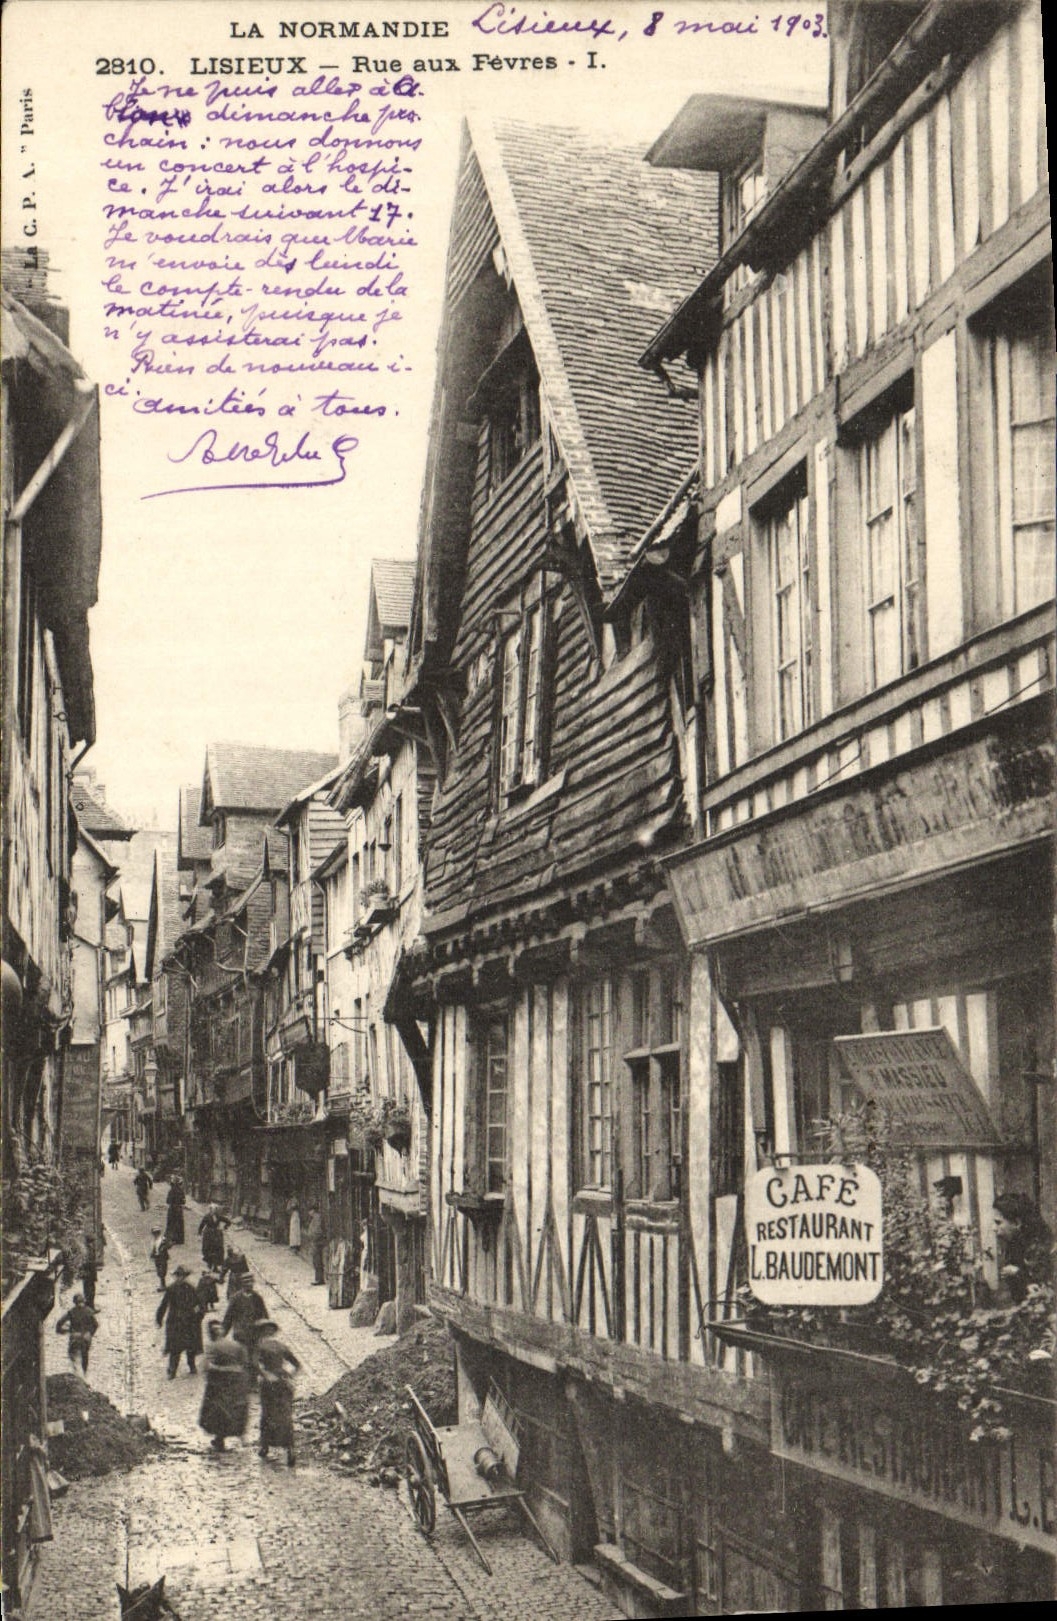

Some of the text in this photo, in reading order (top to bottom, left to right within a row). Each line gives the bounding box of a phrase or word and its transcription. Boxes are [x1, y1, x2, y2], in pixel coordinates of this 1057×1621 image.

[471, 2, 629, 42] Lisieux,
[643, 12, 664, 36] 8
[770, 12, 829, 39] 1903.
[206, 99, 372, 123] dimanche
[100, 159, 145, 172] un
[158, 156, 272, 174] concert
[277, 157, 301, 174] à
[757, 1213, 874, 1243] RESTAURANT
[750, 1244, 881, 1282] L.BAUDEMONT
